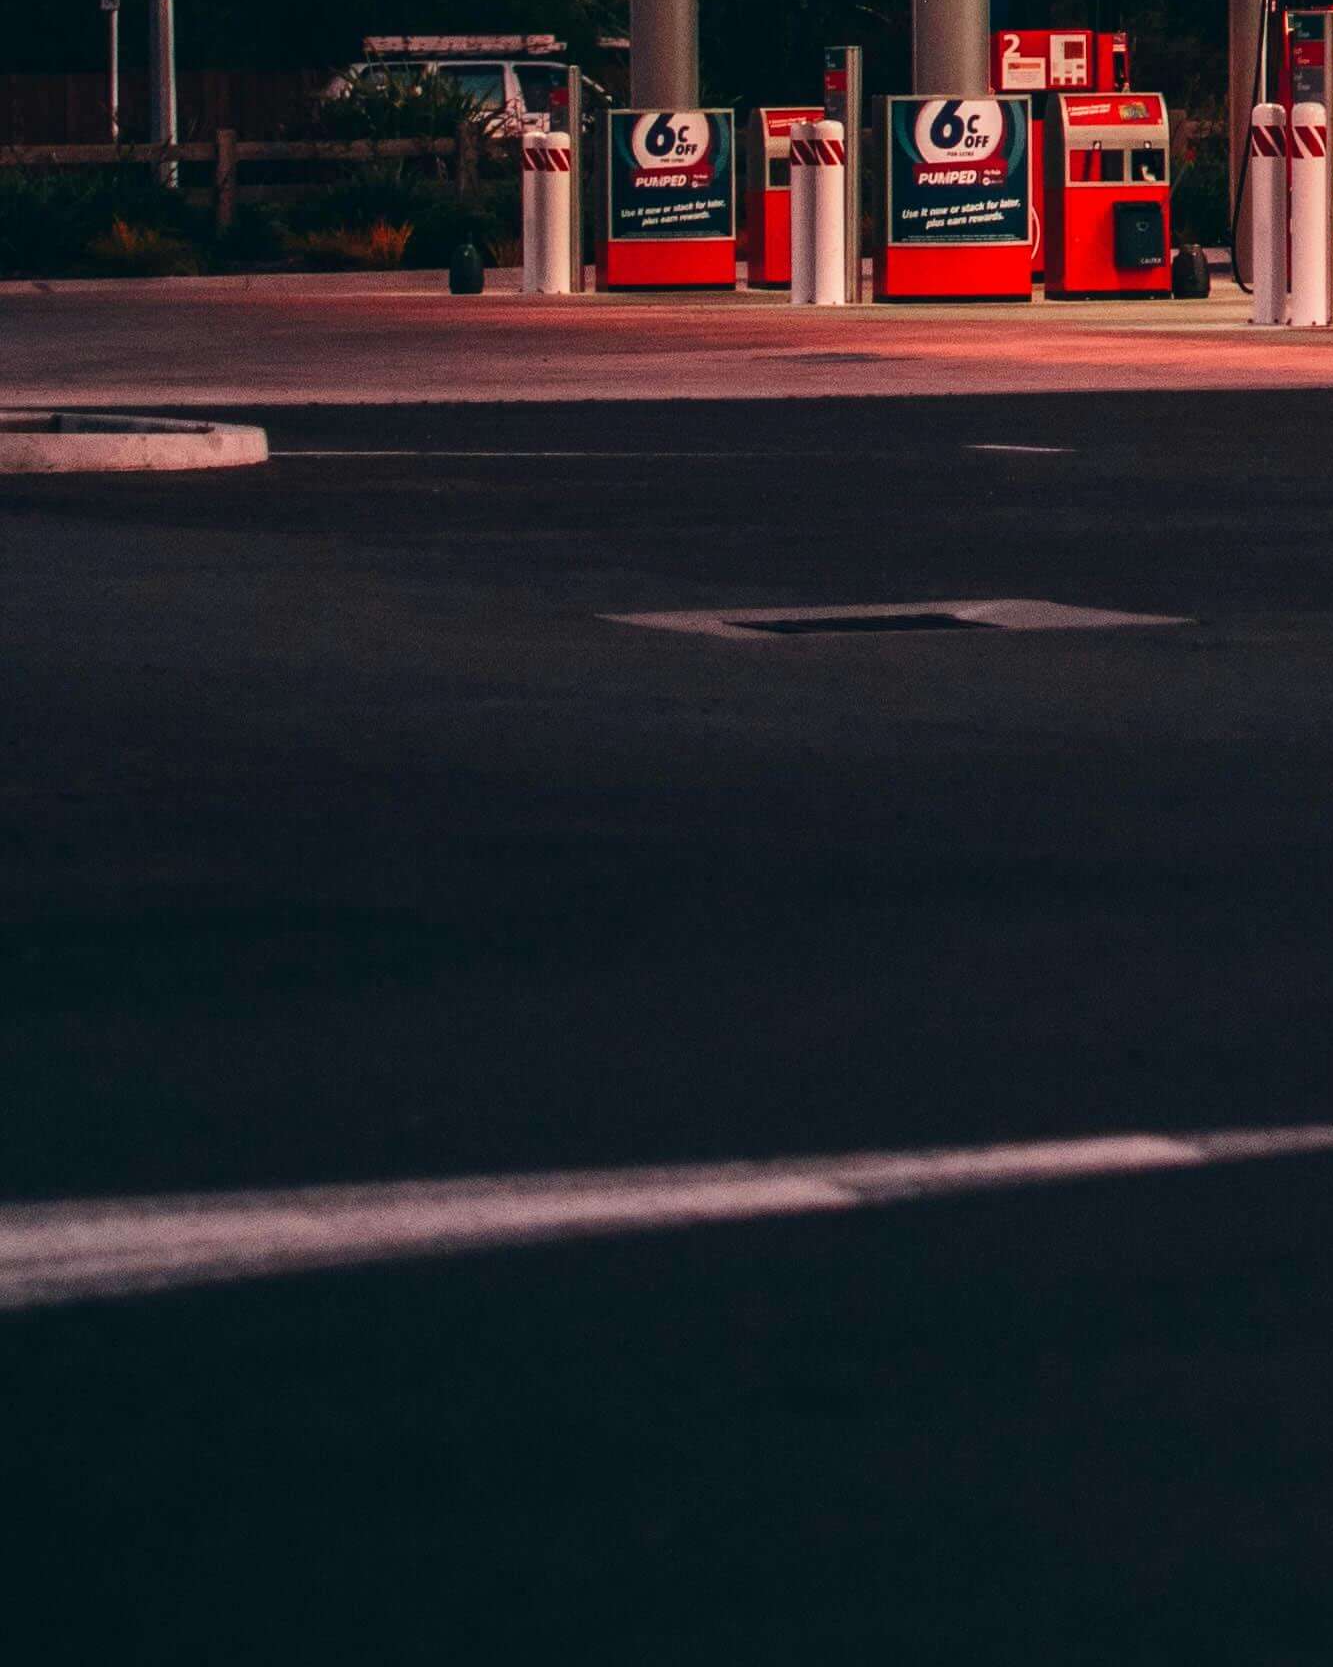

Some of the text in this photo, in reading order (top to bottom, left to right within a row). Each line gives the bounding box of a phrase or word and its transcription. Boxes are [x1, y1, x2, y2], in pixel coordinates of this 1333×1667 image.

[1004, 33, 1021, 59] 2
[965, 135, 990, 148] OFF
[675, 143, 698, 156] OFF
[635, 174, 688, 188] PUMPED
[918, 169, 978, 186] PUMPED
